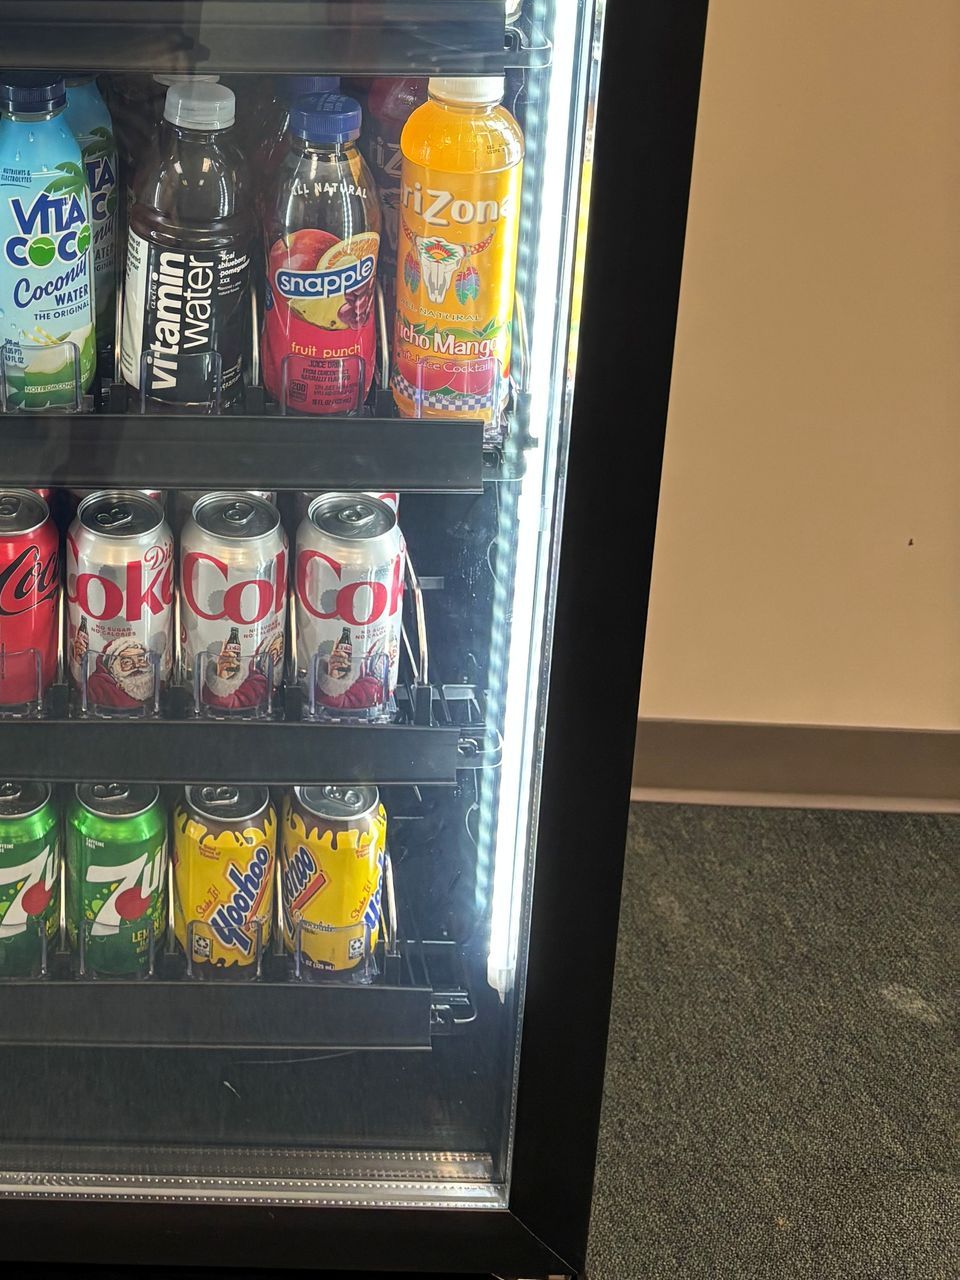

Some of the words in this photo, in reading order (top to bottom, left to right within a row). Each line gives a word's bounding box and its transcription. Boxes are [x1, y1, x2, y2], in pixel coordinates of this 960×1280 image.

[314, 181, 368, 199] NATURAL
[10, 192, 87, 236] VITA
[5, 224, 91, 269] COCO
[13, 250, 88, 310] Coconut
[280, 260, 373, 297] snapple
[54, 283, 89, 307] WATER
[183, 254, 215, 350] water
[33, 312, 52, 321] THE
[53, 301, 90, 320] ORIGINAL
[147, 251, 185, 391] vitamin
[290, 342, 317, 356] fruit
[323, 344, 361, 359] punch
[433, 332, 497, 359] Mango
[91, 627, 102, 635] NO
[96, 624, 107, 632] NO
[196, 893, 214, 919] Shake
[208, 884, 220, 900] It!
